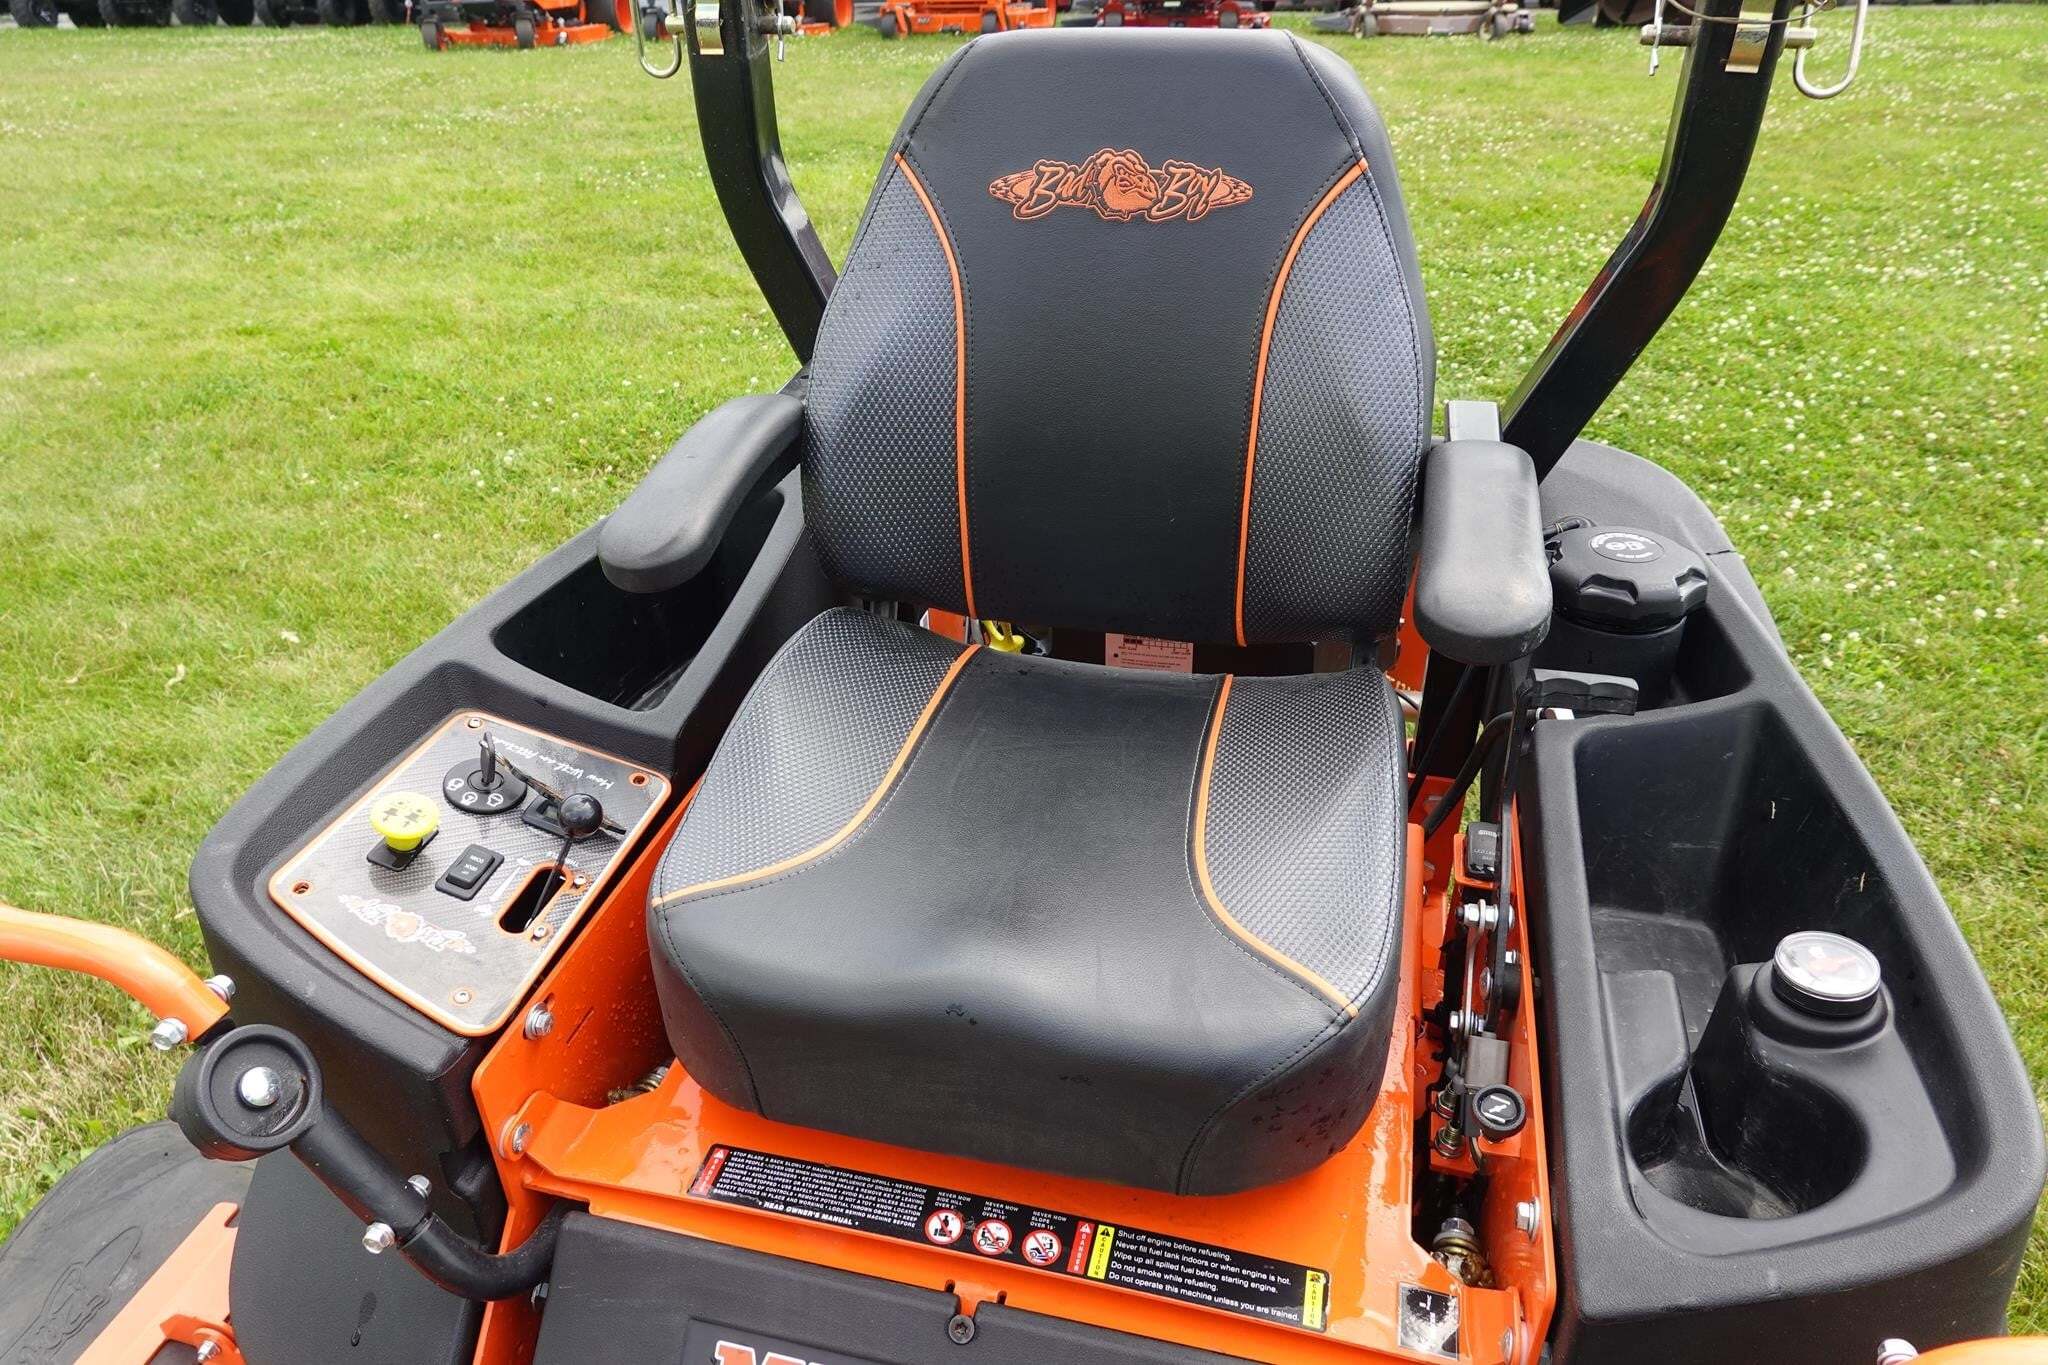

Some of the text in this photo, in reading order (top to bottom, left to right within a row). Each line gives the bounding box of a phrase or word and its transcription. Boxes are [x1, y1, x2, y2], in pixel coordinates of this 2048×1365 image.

[1016, 161, 1220, 219] Bad Boy
[724, 1167, 748, 1175] MACHINE
[768, 1176, 792, 1184] SLIPPERY
[877, 1198, 899, 1206] UNLESS
[899, 1202, 918, 1210] BLADE
[764, 1169, 798, 1179] PASSENGERS
[812, 1179, 836, 1187] PARKING
[860, 1188, 882, 1196] REMOVE
[901, 1196, 925, 1205] LEAVING
[812, 1167, 836, 1175] MACHINE
[838, 1178, 866, 1187] INFLUENCE
[875, 1185, 893, 1193] DRUGS
[902, 1190, 926, 1199] ALCOHOL
[716, 1183, 737, 1191] SAFETY
[737, 1187, 761, 1196] DEVICES
[798, 1200, 824, 1209] WORKING
[845, 1209, 866, 1218] BEHIND
[867, 1214, 892, 1223] MACHINE
[893, 1219, 916, 1228] BEFORE
[731, 1180, 757, 1189] FUNCTION
[765, 1187, 794, 1196] CONTROLS
[798, 1194, 820, 1202] REMOVE
[820, 1198, 849, 1208] POTENTIAL
[873, 1209, 898, 1218] OBJECTS
[753, 1179, 777, 1187] STOPPED
[814, 1191, 838, 1199] MACHINE
[893, 1207, 921, 1216] LOCATION
[786, 1207, 820, 1218] OWNER'S
[821, 1214, 854, 1225] MANUAL
[985, 1201, 1004, 1209] NEVER
[1033, 1211, 1052, 1219] NEVER
[1031, 1216, 1050, 1224] SLOPE
[1073, 1234, 1086, 1271] DANGER
[1094, 1236, 1107, 1275] CAUTION
[1116, 1240, 1138, 1251] Never
[1139, 1245, 1148, 1253] fill
[1149, 1247, 1163, 1256] fuel
[1164, 1251, 1180, 1260] tank
[1182, 1255, 1209, 1267] indoors
[1221, 1263, 1240, 1274] when
[1242, 1268, 1267, 1281] engine
[1269, 1274, 1275, 1282] is
[1278, 1276, 1291, 1285] hot.
[1118, 1230, 1232, 1262] Shut off engine before refueling.
[1111, 1261, 1219, 1292] Do not smoke while refueling.
[1113, 1251, 1133, 1262] Wipe
[1134, 1256, 1144, 1264] up
[1155, 1260, 1179, 1272] spilled
[1181, 1266, 1195, 1274] fuel
[1196, 1269, 1219, 1280] before
[1221, 1274, 1249, 1288] starting
[1251, 1281, 1278, 1294] engine.
[1109, 1272, 1120, 1280] Do
[1121, 1275, 1134, 1283] not
[1135, 1278, 1164, 1292] operate
[1165, 1284, 1179, 1294] this
[1181, 1288, 1212, 1301] machine
[1214, 1295, 1239, 1307] unless
[1241, 1303, 1254, 1312] you
[1272, 1308, 1299, 1321] trained.
